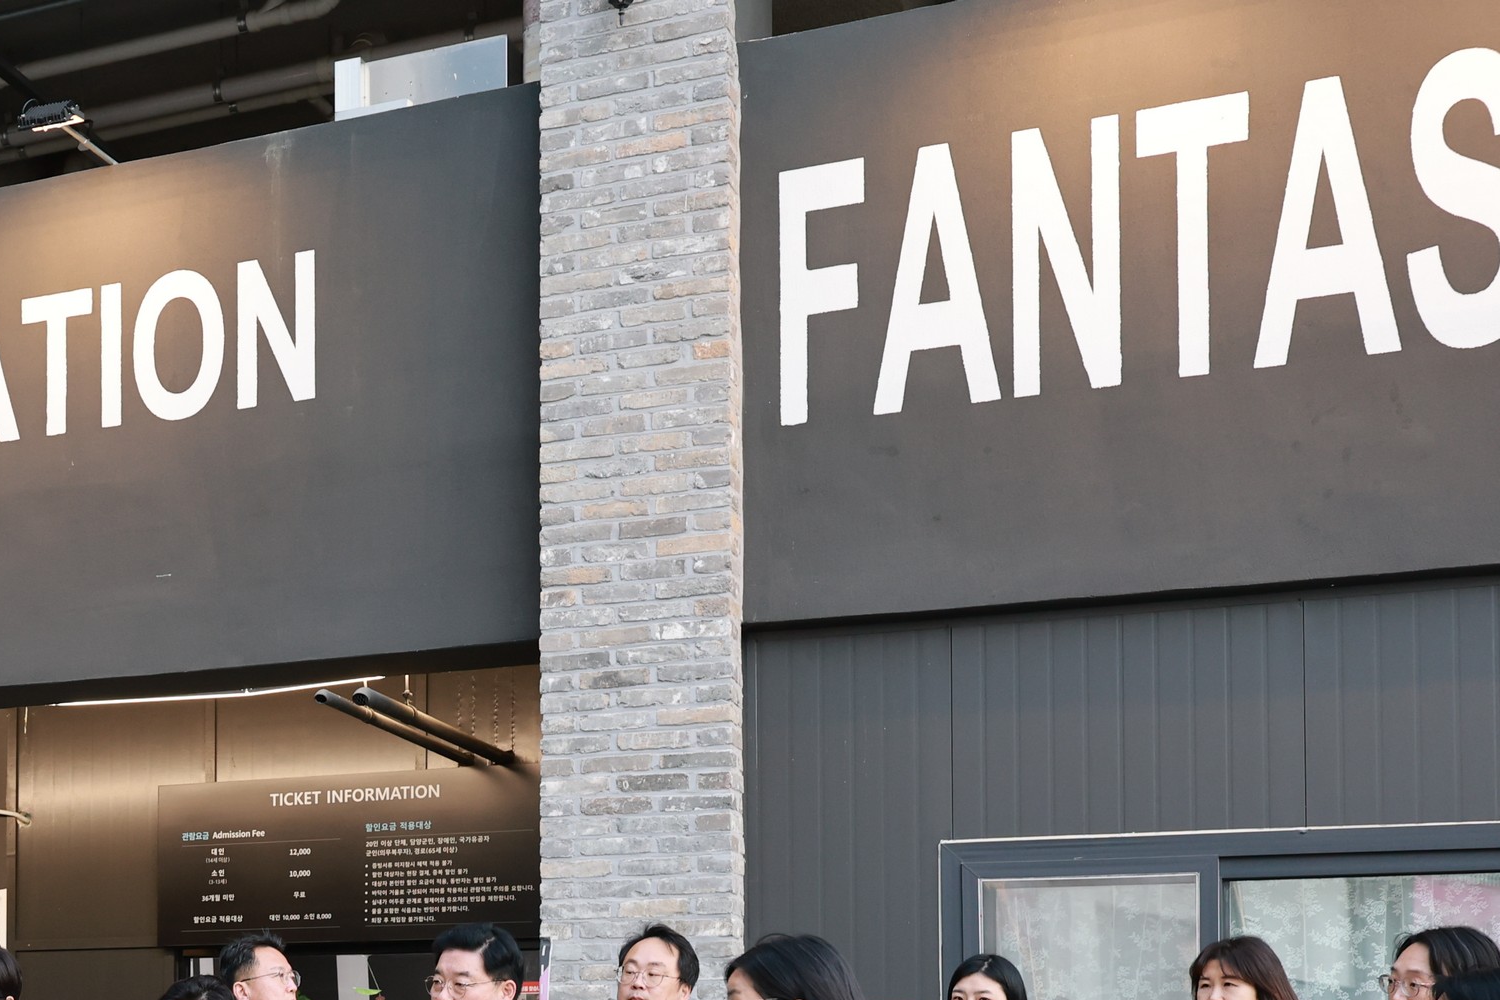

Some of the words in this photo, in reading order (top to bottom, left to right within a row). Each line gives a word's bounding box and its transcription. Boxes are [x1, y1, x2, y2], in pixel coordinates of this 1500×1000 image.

[270, 790, 320, 808] TICKET
[326, 784, 441, 804] INFORMATION
[365, 822, 396, 832] 할인요금
[400, 820, 432, 831] 적용대상
[182, 831, 210, 842] 관람요금
[212, 830, 251, 840] Admission
[252, 829, 266, 838] Fee
[365, 840, 379, 848] 20인
[380, 839, 393, 847] 이상
[459, 835, 490, 843] 국가유공자
[211, 848, 225, 856] 대인
[289, 848, 311, 857] 12,000
[211, 869, 225, 877] 소인
[289, 870, 311, 879] 10,000
[201, 894, 220, 902] 36개월
[293, 891, 306, 899] 무료
[193, 916, 218, 924] 할인요금
[219, 915, 243, 923] 적용대상
[269, 914, 281, 922] 대인
[282, 914, 301, 922] 10,000
[303, 913, 315, 921] 소인
[316, 912, 332, 921] 8,000
